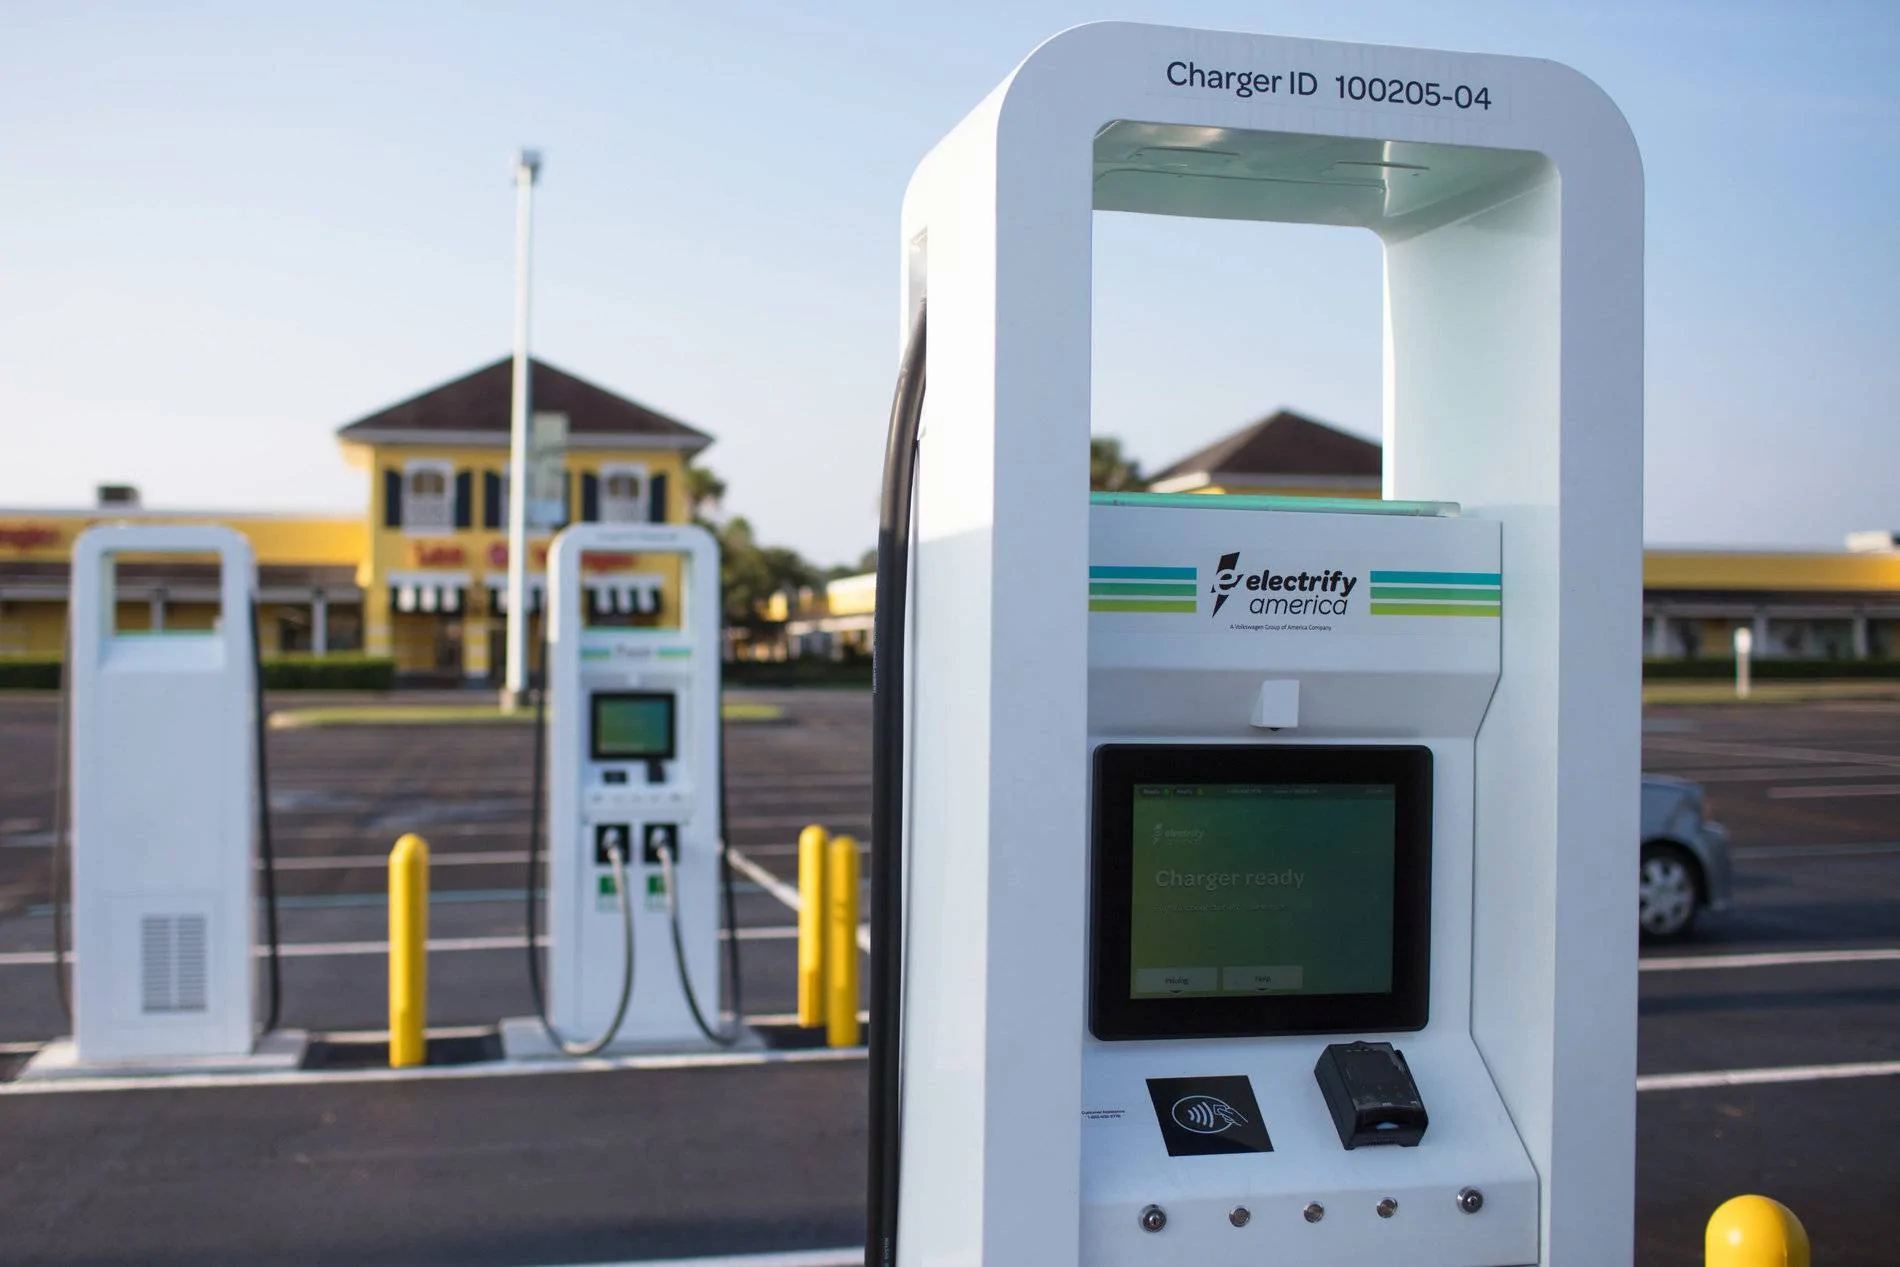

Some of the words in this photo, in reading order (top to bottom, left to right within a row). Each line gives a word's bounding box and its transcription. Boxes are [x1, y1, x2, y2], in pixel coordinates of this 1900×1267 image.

[1166, 61, 1282, 98] Charger
[1289, 71, 1318, 96] ID
[1335, 74, 1492, 111] 100205-04
[1246, 570, 1357, 597] electrify
[1250, 595, 1348, 615] america
[1155, 869, 1243, 891] Charger
[1245, 868, 1306, 889] ready
